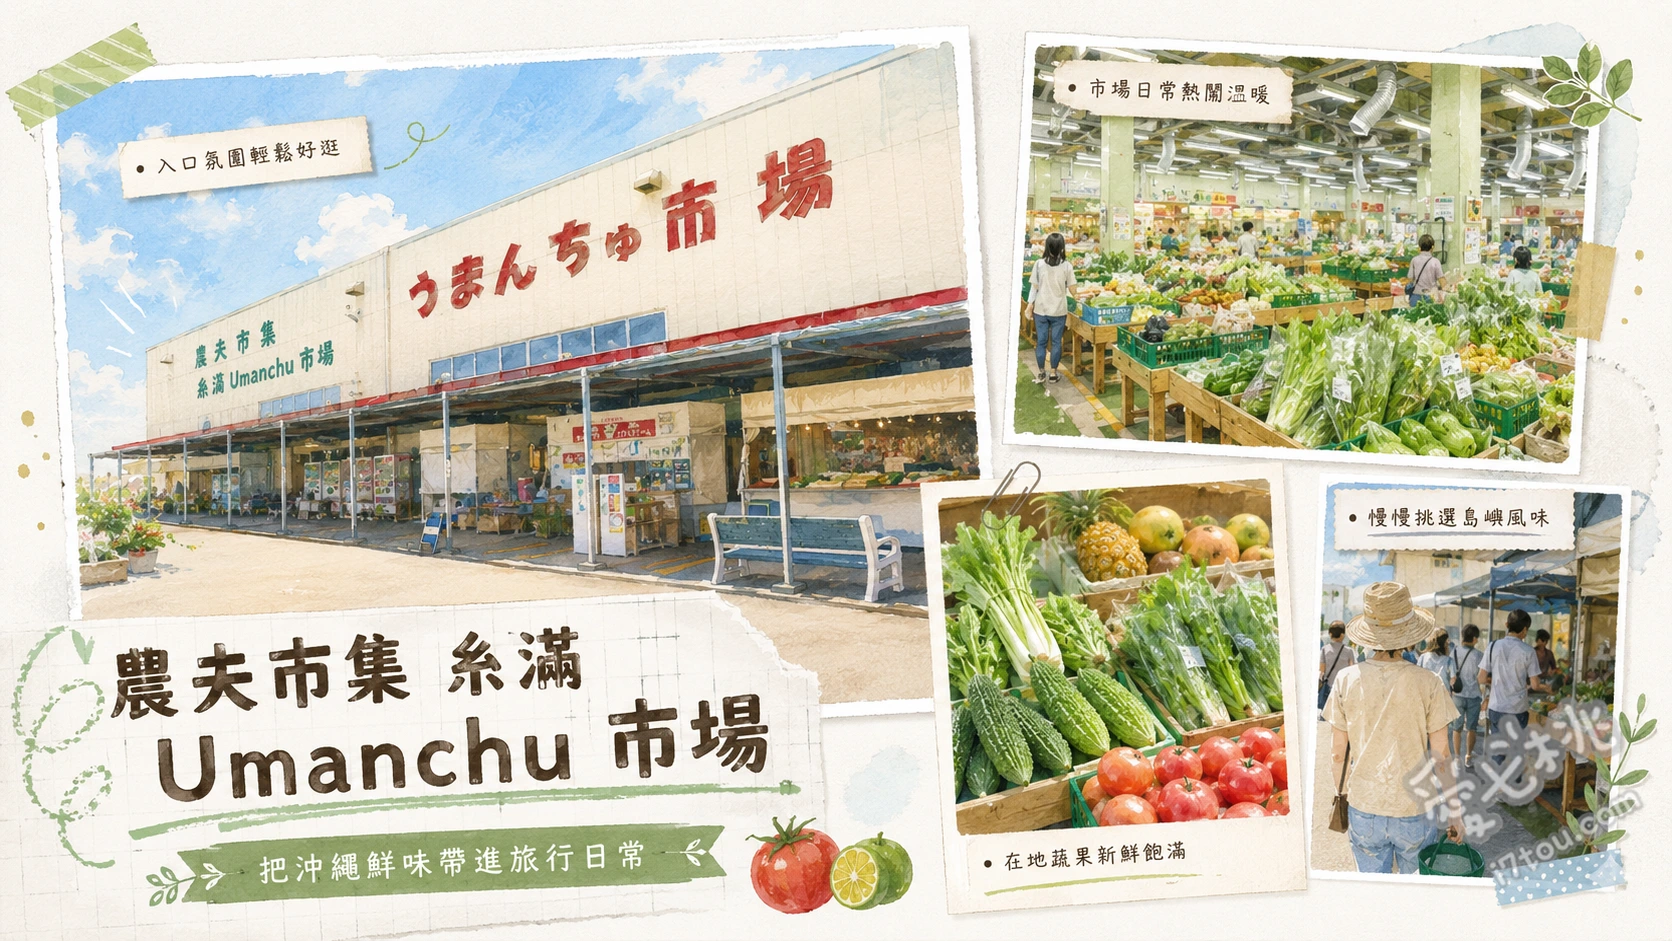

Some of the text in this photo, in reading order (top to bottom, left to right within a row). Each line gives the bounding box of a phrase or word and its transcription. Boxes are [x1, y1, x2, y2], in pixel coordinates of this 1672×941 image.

[409, 137, 833, 318] うまんちゅ市場
[195, 319, 276, 369] 農夫市集
[230, 357, 294, 389] Umanchu
[299, 340, 334, 372] 市場
